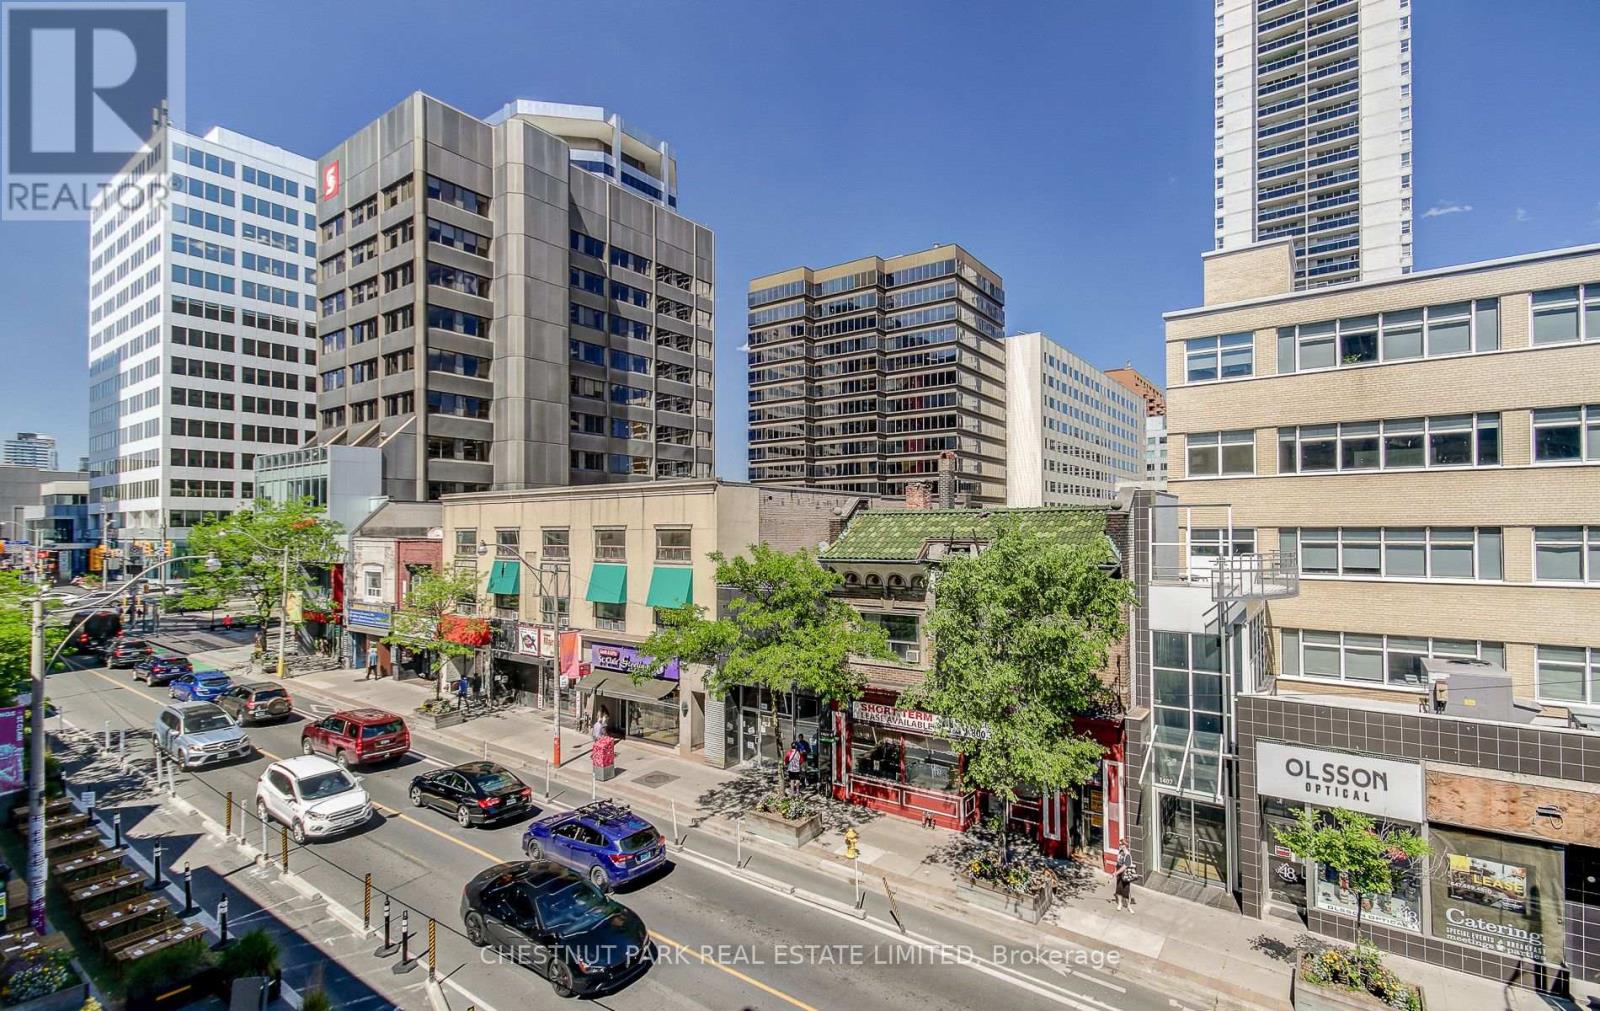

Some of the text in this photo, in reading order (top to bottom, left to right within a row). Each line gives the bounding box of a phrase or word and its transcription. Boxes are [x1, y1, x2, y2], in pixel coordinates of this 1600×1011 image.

[860, 703, 933, 722] SHORT TERM
[885, 714, 934, 730] AVAILABLE
[1285, 758, 1388, 791] OLSSON
[1305, 782, 1370, 802] OPTICAL
[1473, 874, 1524, 895] LEASE
[1445, 908, 1543, 946] Catering
[1446, 927, 1546, 955] SPECIAL EVENTS BREAKFAST
[1446, 934, 1495, 950] meetings
